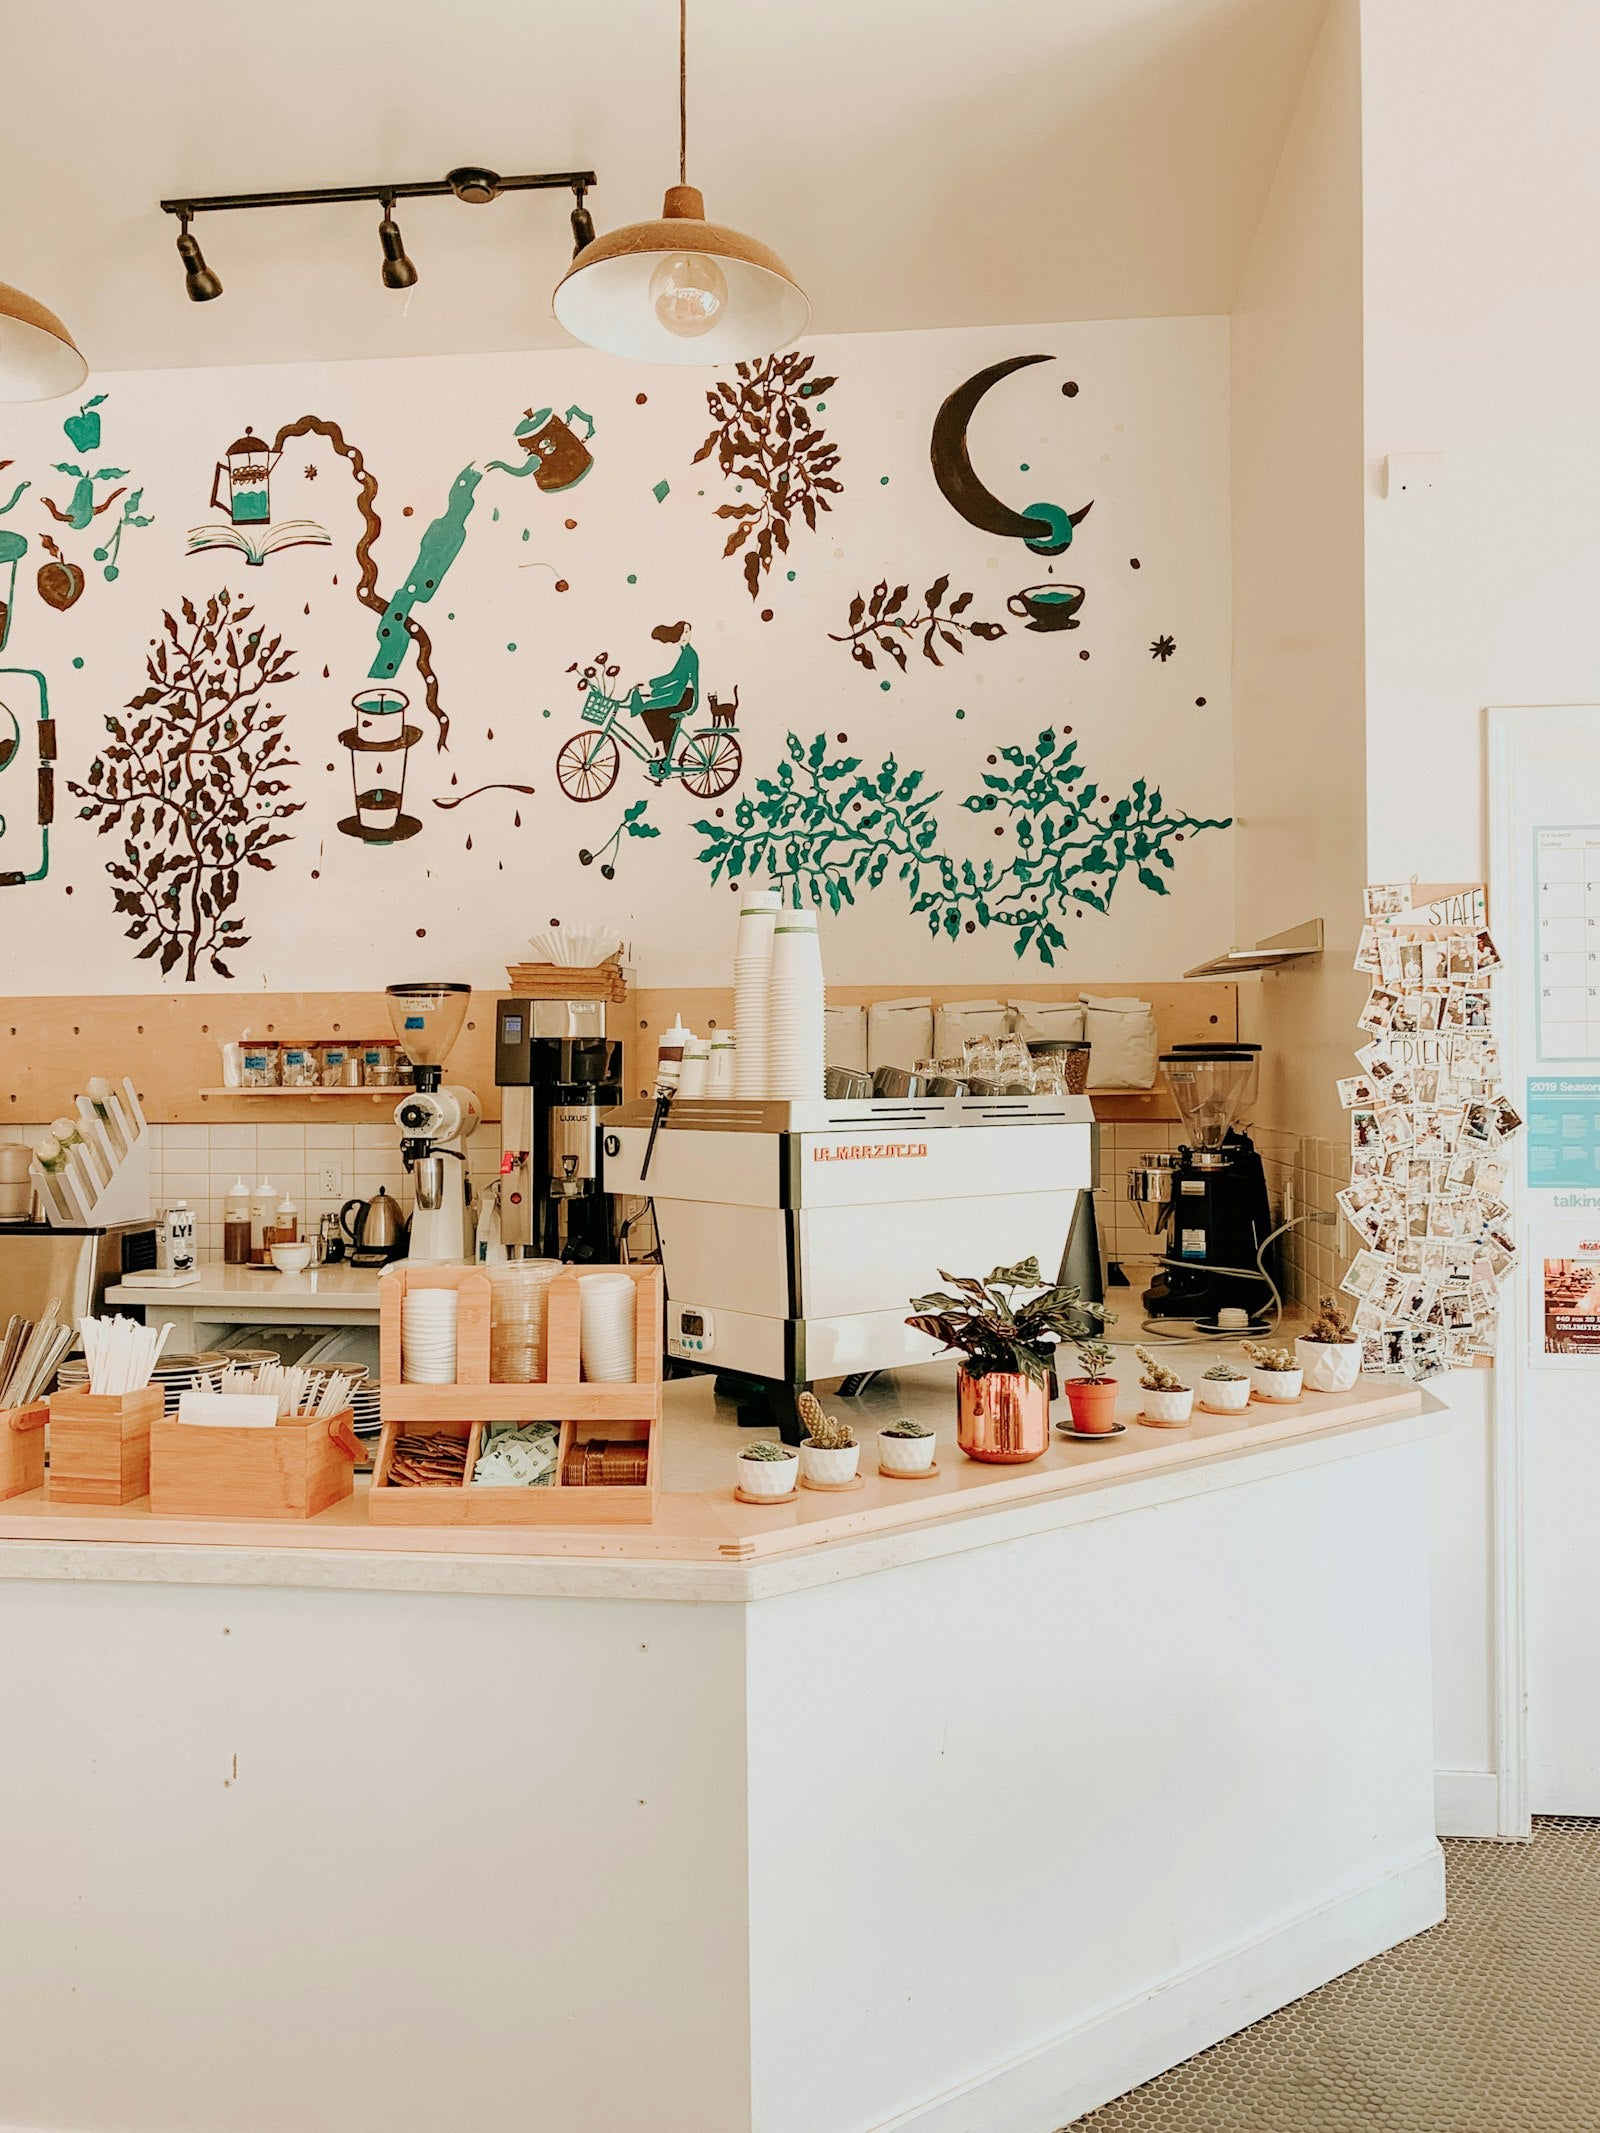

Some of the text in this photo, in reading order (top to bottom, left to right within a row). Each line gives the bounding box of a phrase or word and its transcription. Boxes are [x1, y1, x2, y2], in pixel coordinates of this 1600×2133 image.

[1586, 882, 1592, 891] 5
[1428, 888, 1482, 926] STAFF
[1530, 1081, 1600, 1092] 2019 Season
[560, 1114, 588, 1122] LUXUS
[168, 1211, 195, 1226] OAT
[172, 1224, 193, 1238] LY!
